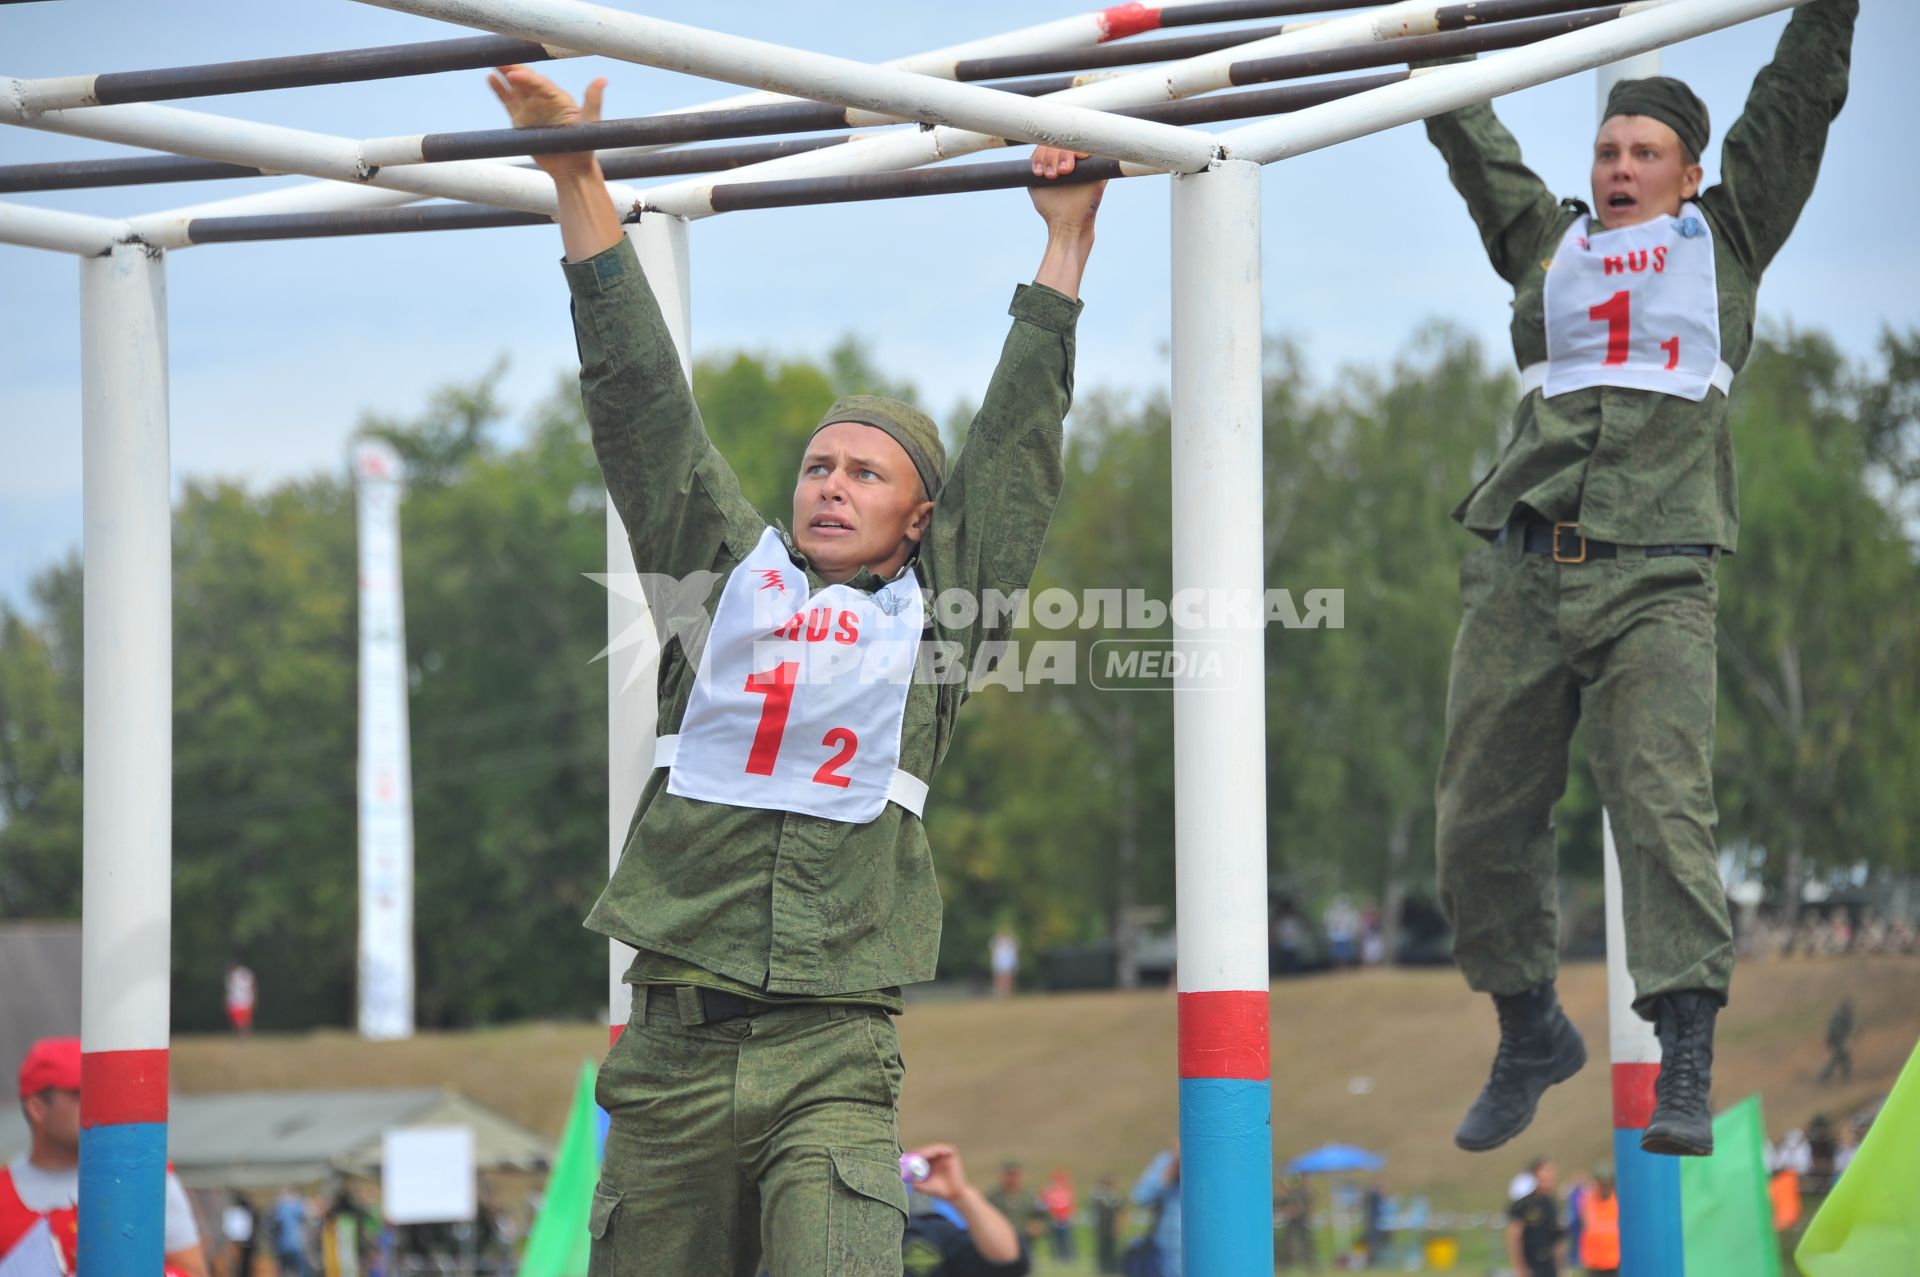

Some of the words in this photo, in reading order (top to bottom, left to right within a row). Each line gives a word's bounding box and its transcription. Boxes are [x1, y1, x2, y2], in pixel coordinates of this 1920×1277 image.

[1603, 246, 1668, 276] RUS
[1589, 290, 1630, 366] 1
[1660, 336, 1679, 370] 1
[773, 607, 860, 645] RUS
[744, 661, 800, 776] 1
[812, 727, 859, 789] 2
